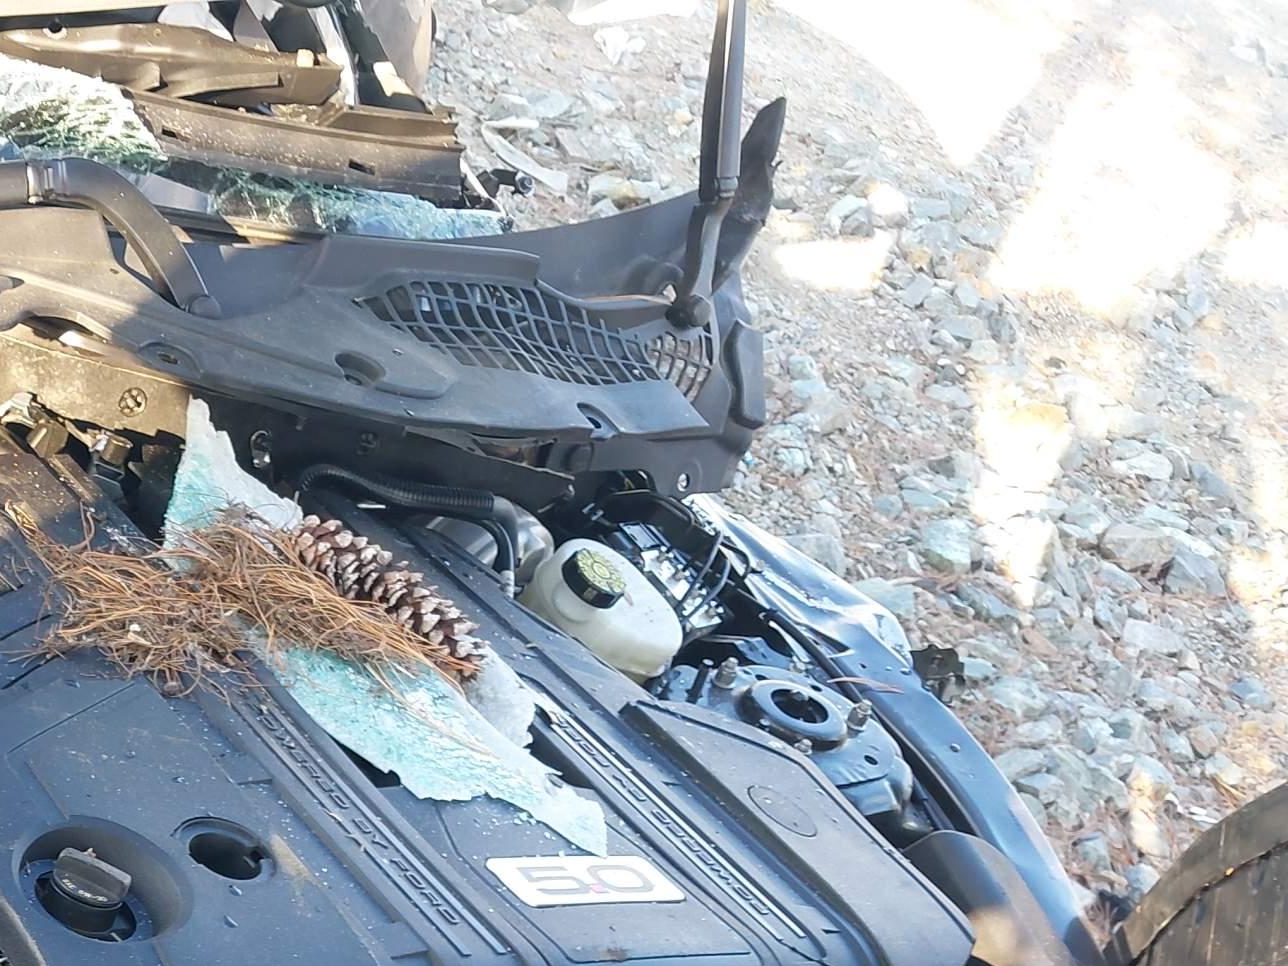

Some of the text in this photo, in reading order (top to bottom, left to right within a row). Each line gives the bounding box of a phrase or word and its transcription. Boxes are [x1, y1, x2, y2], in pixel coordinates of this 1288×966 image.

[352, 817, 389, 849] BY
[390, 857, 460, 925] FORD
[516, 865, 655, 895] 5.0
